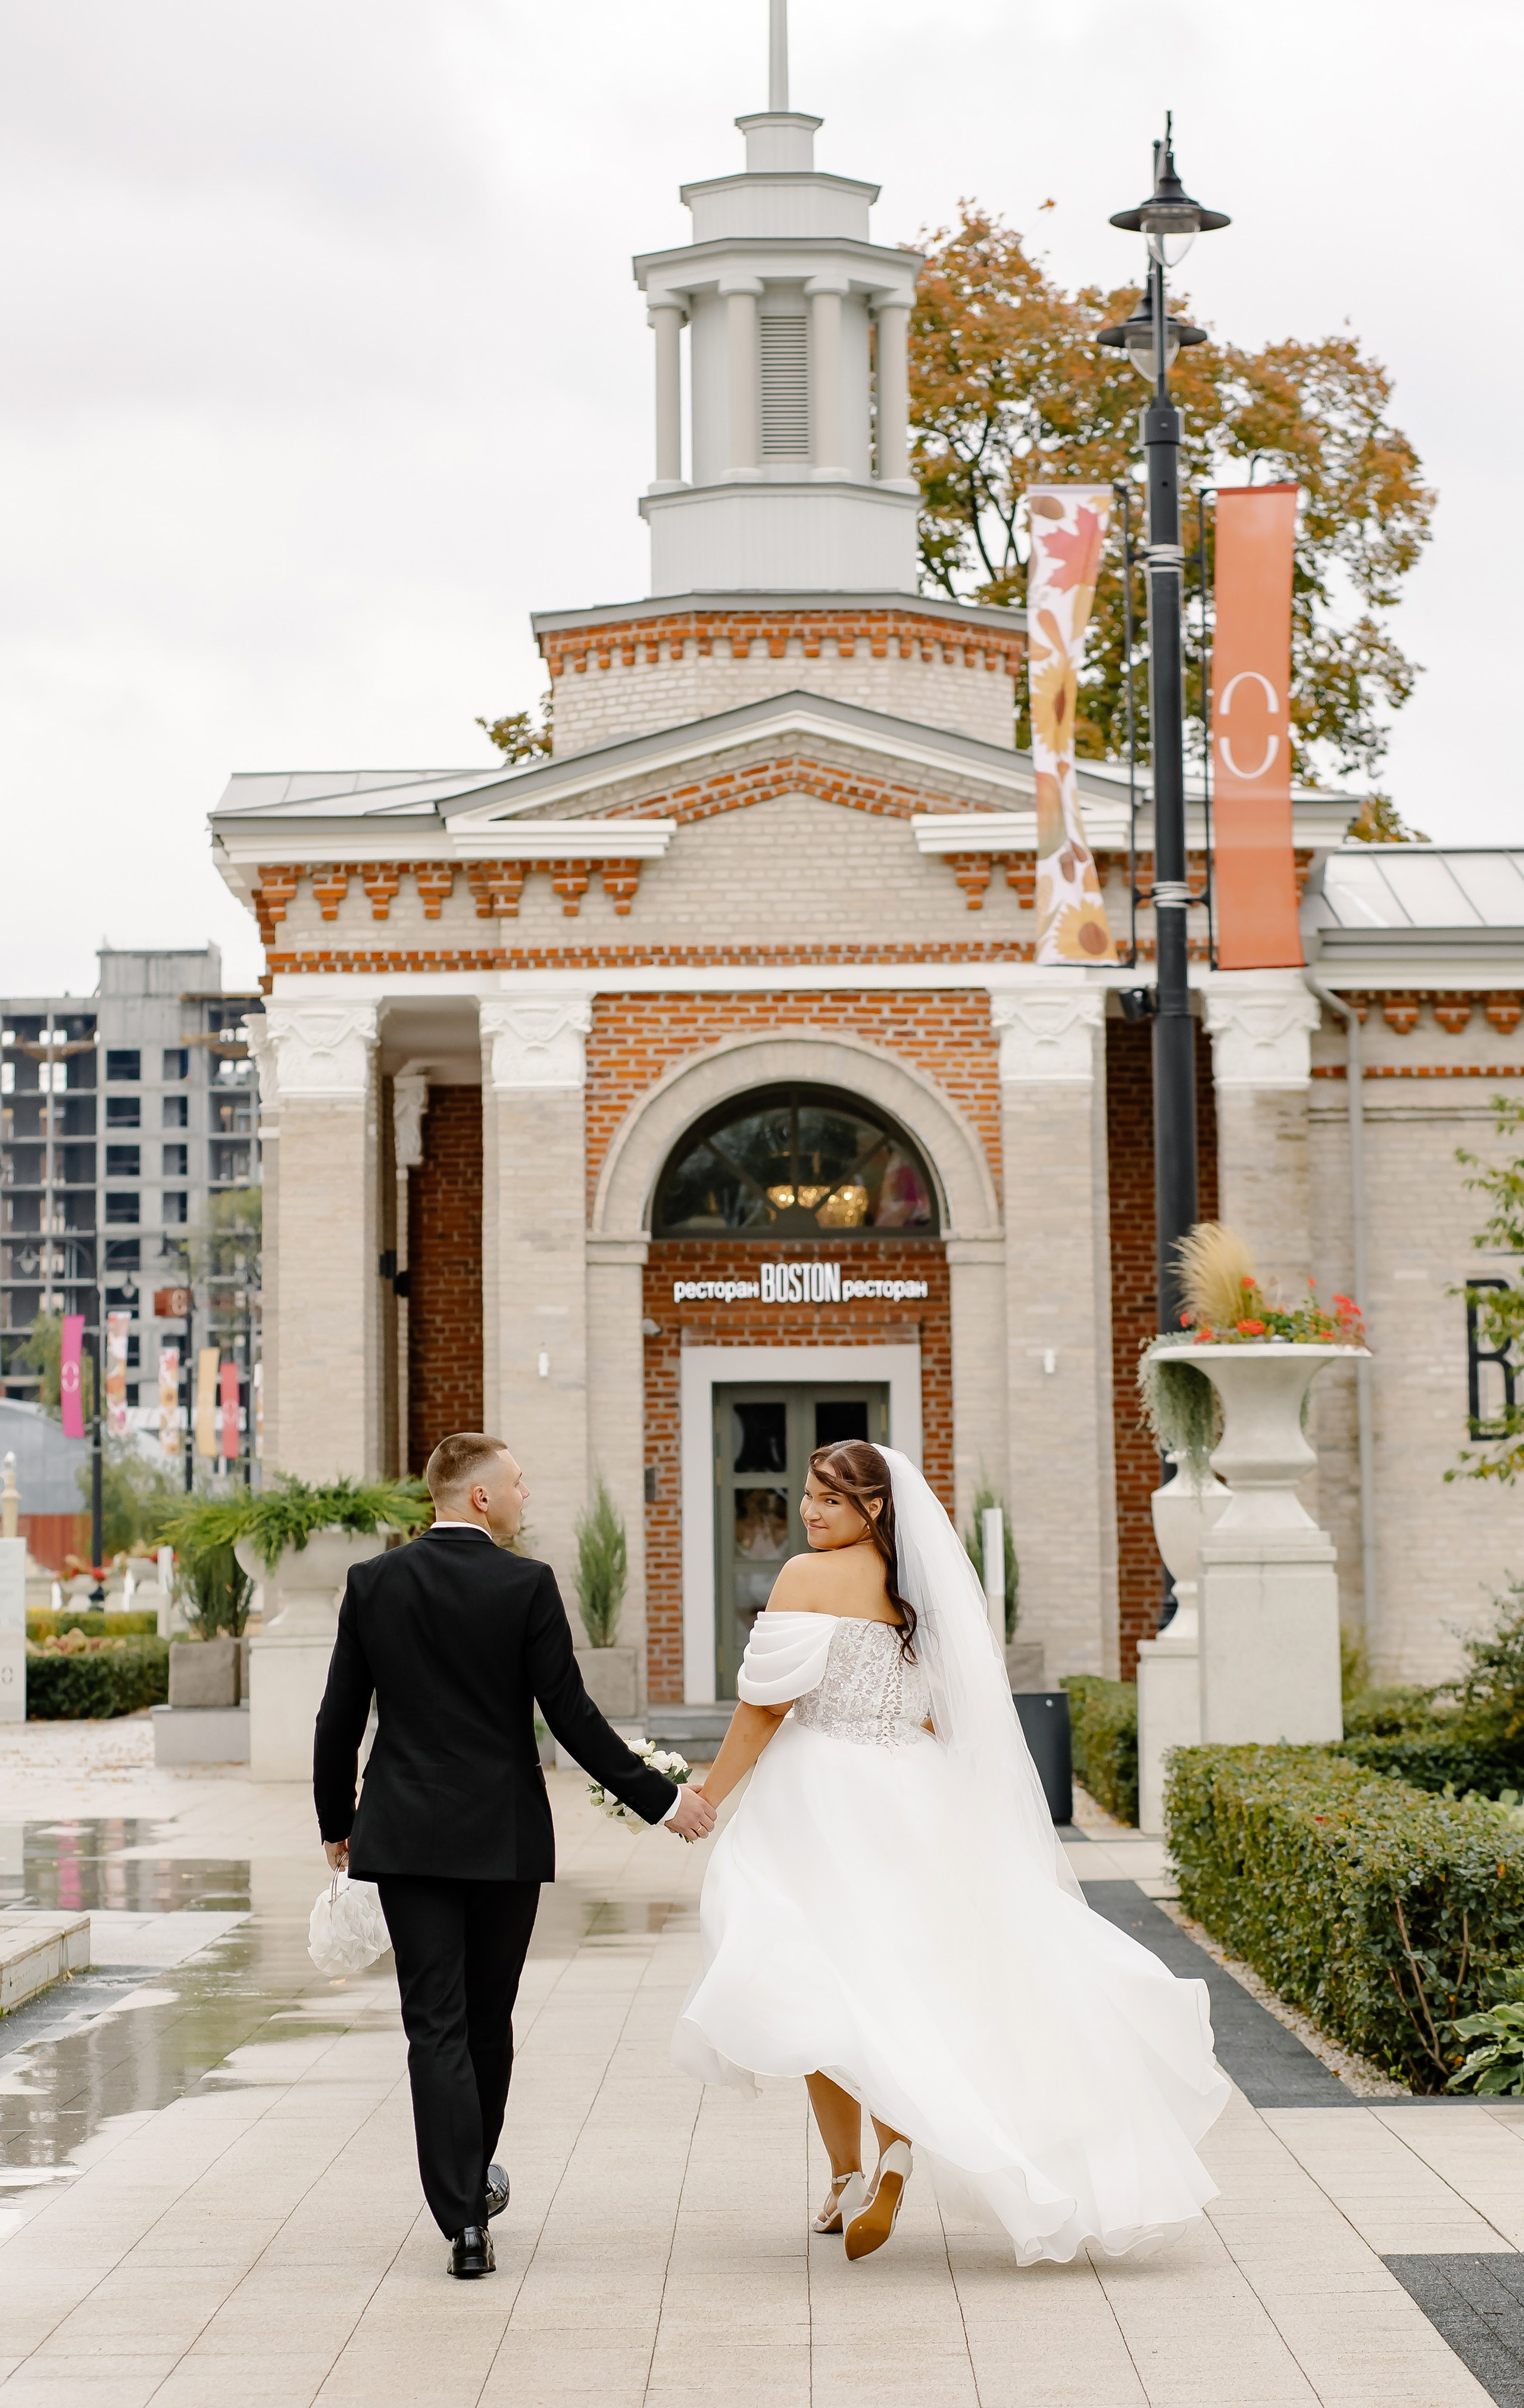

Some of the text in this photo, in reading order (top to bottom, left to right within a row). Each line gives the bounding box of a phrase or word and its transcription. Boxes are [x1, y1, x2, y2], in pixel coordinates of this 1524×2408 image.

[674, 1263, 927, 1303] ресторан BOSTON ресторан
